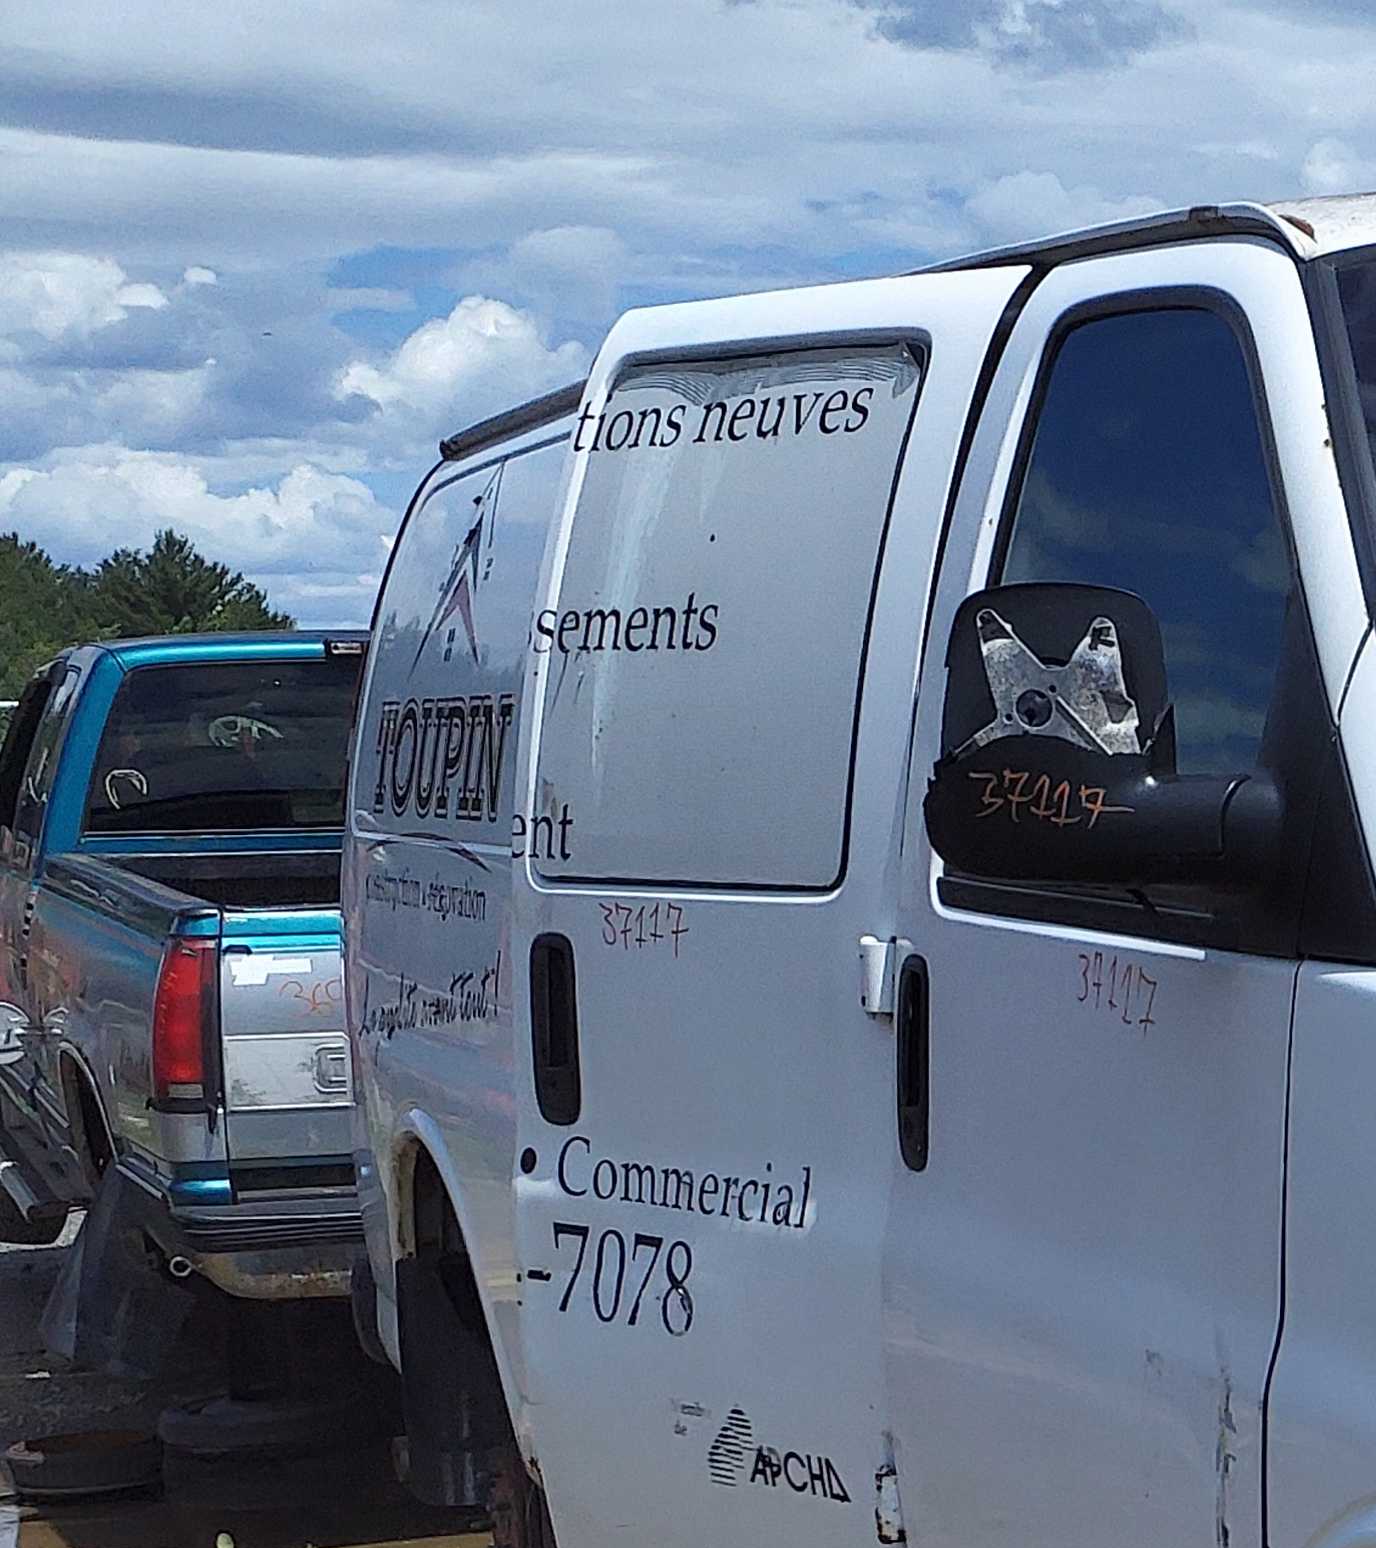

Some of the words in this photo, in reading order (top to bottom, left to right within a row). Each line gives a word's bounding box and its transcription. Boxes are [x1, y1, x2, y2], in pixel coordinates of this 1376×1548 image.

[692, 387, 875, 443] neuves
[527, 592, 720, 653] sements
[373, 694, 516, 823] TOUPIN
[968, 767, 1136, 829] 37117
[598, 902, 690, 958] 37117
[1077, 951, 1158, 1036] 37117
[557, 1136, 811, 1229] Commercial
[516, 1222, 693, 1336] -7078
